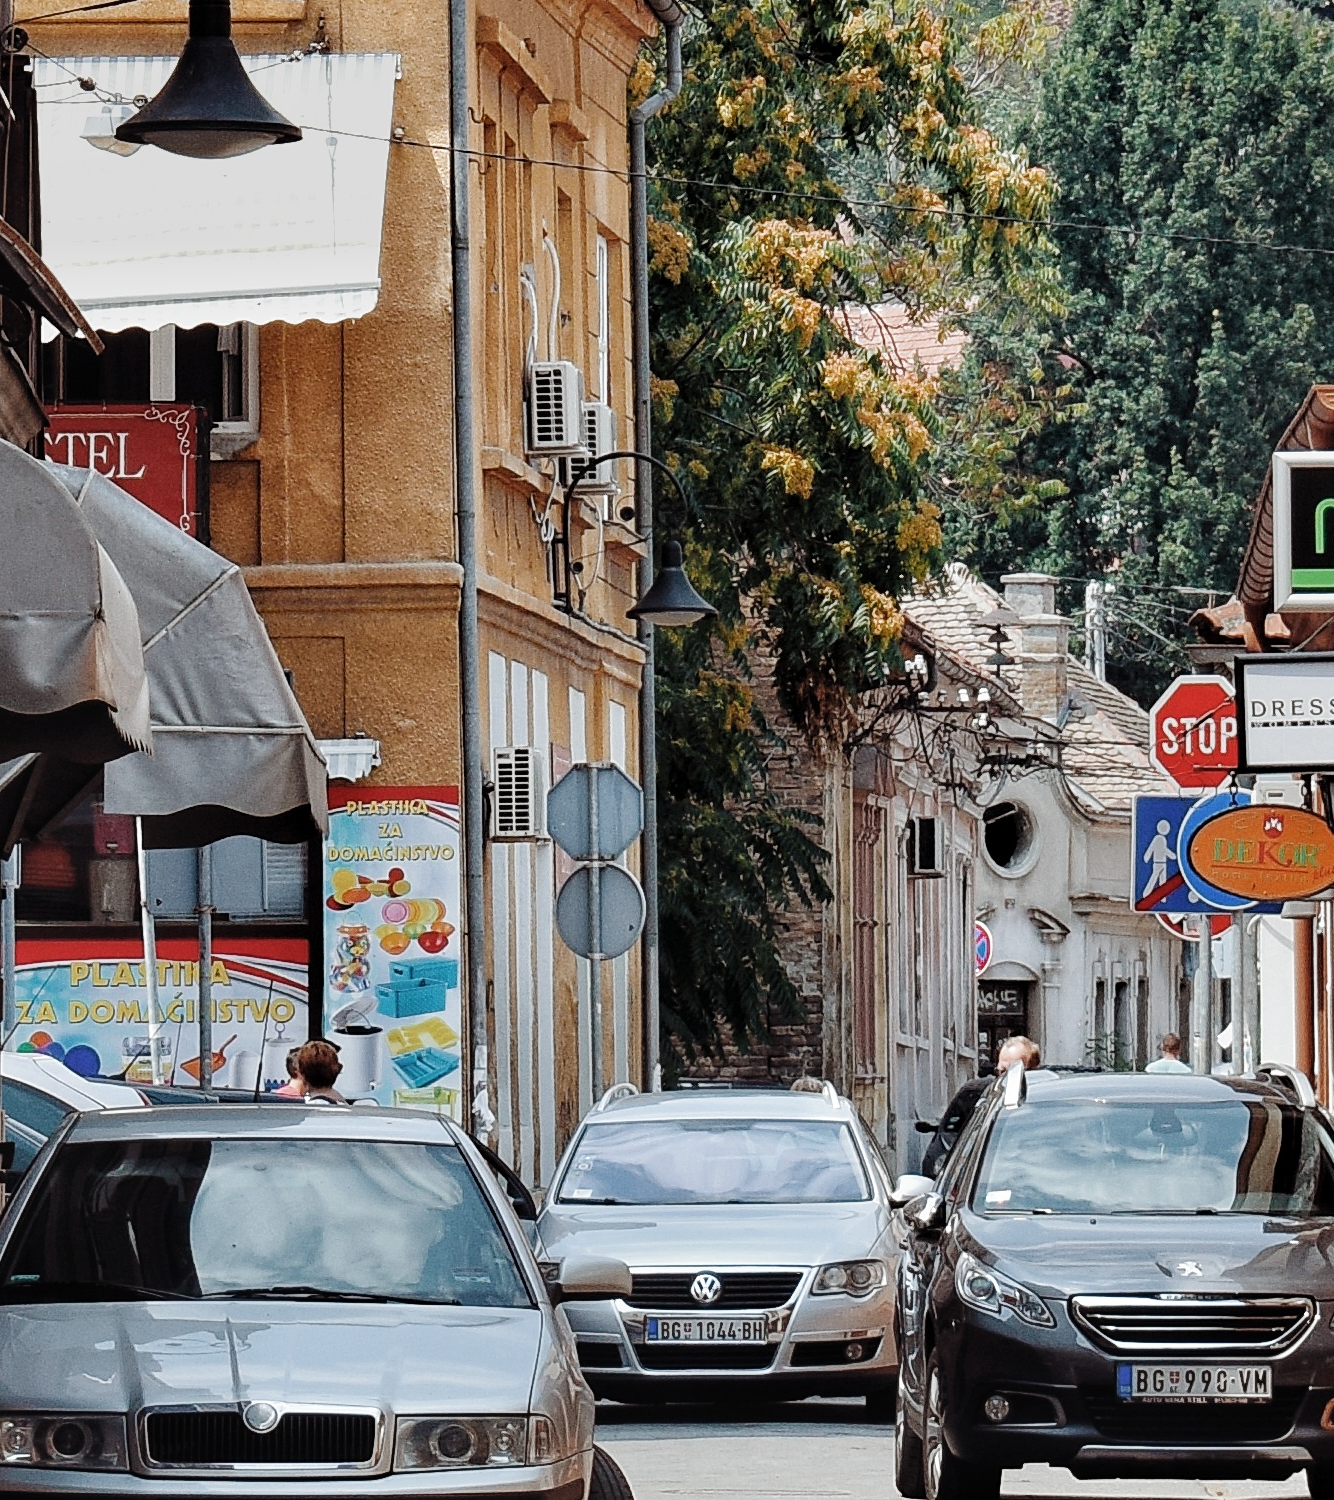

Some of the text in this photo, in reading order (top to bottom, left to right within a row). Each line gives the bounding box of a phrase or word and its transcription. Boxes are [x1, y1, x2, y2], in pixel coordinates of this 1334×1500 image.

[1162, 716, 1238, 755] STOP
[347, 800, 429, 817] PLASTIKA
[379, 822, 404, 839] ZA
[327, 841, 455, 862] DOMAĆINSTVO
[15, 1000, 58, 1024] ZA
[660, 1321, 681, 1340] BG
[1136, 1369, 1165, 1393] BG
